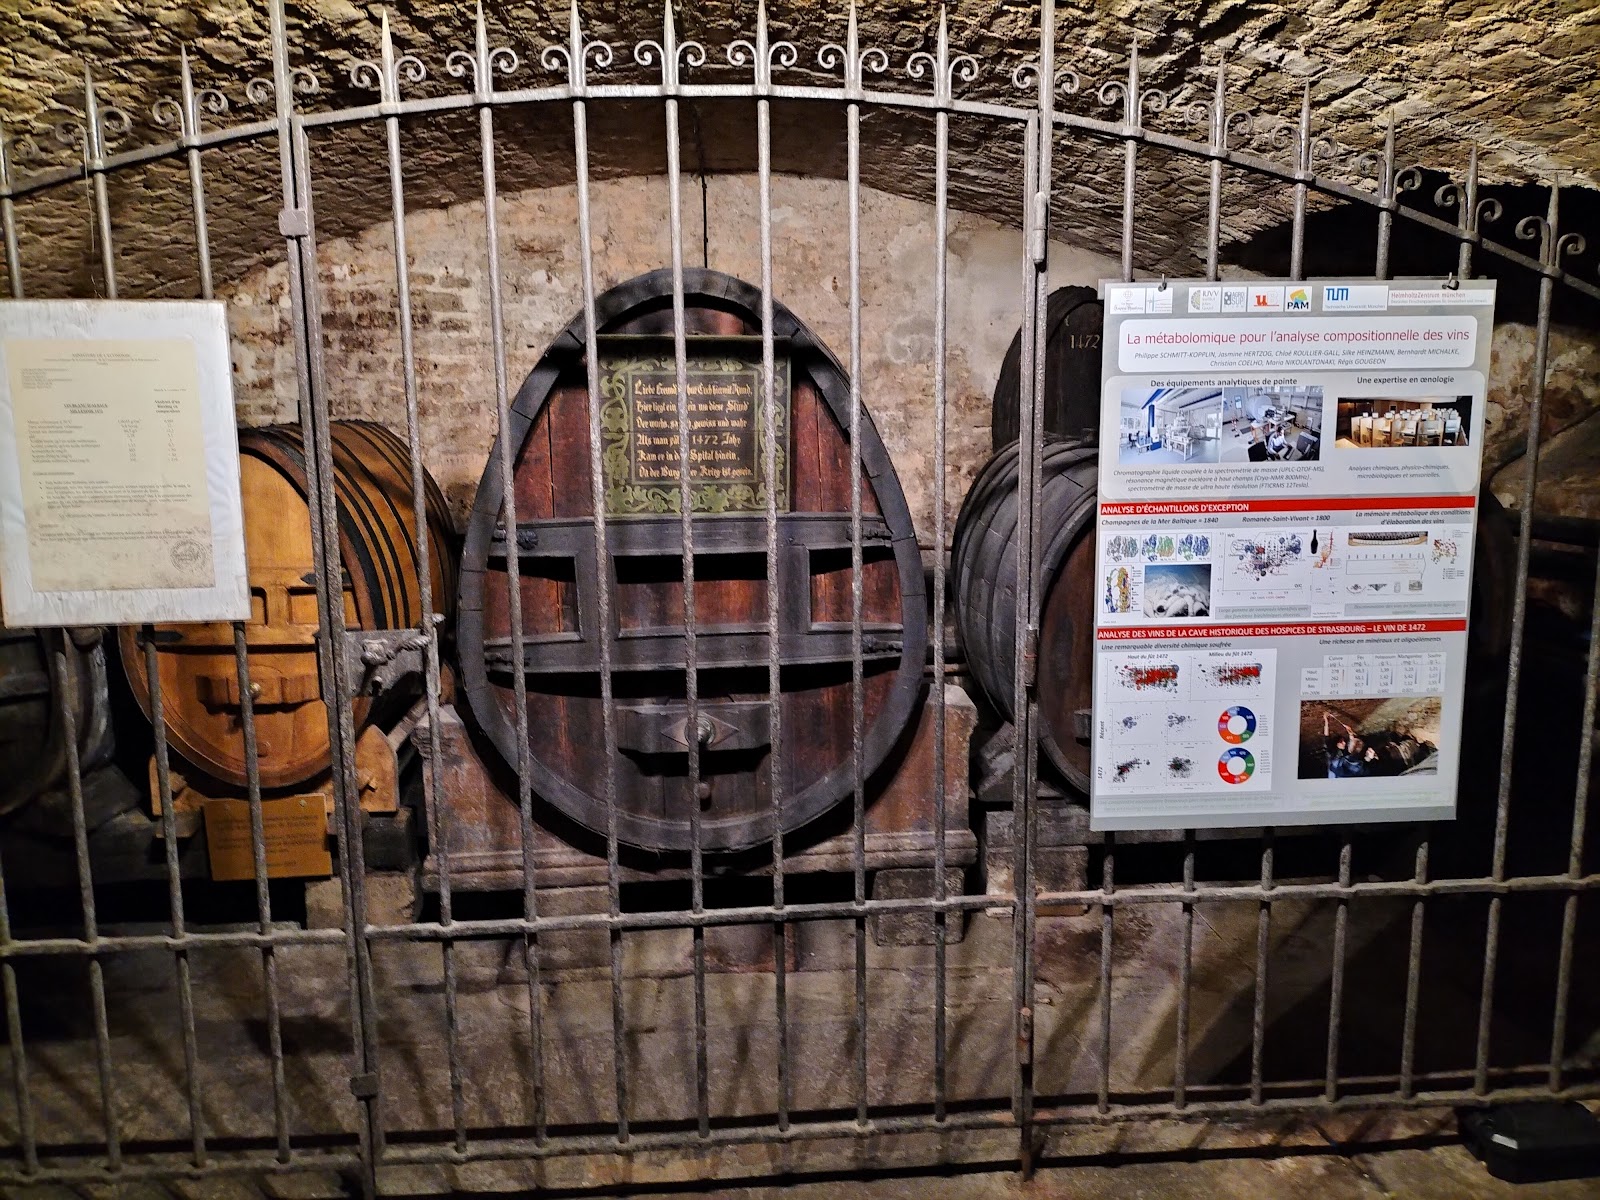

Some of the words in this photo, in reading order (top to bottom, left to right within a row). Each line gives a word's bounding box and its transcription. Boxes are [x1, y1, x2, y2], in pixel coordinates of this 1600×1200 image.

[1287, 301, 1309, 310] PAM
[1070, 334, 1100, 350] 1472
[1127, 333, 1141, 345] La
[1145, 331, 1236, 345] métabolomique
[1240, 332, 1267, 345] pour
[1323, 329, 1420, 344] compositionnelle
[1423, 329, 1443, 341] des
[1447, 329, 1470, 341] vins
[1134, 352, 1159, 360] Philippe
[1159, 351, 1216, 359] SCHMITT-KOPPLIN,
[1243, 350, 1273, 358] HERTZOG,
[1356, 349, 1396, 357] HEINZMANN,
[1427, 348, 1460, 356] MICHALKE,
[1238, 359, 1265, 367] COELHO,
[1285, 358, 1336, 366] NIKOLANTONAKI,
[1338, 358, 1353, 366] Régis
[1166, 379, 1216, 388] équipements
[1217, 379, 1261, 388] analytiques
[1273, 378, 1298, 387] pointe
[1357, 376, 1372, 384] Une
[1373, 376, 1408, 385] expertise
[717, 416, 730, 428] und
[692, 434, 719, 445] 1472
[1113, 469, 1161, 477] Chromatographie
[1181, 468, 1201, 476] couplée
[1215, 467, 1252, 475] spectrométrie
[1154, 477, 1188, 485] magnétique
[1101, 505, 1135, 514] ANALYSE
[1101, 518, 1140, 527] Champagnes
[1242, 514, 1310, 522] Romanée-Saint-Vivant
[1098, 630, 1131, 639] ANALYSE
[1133, 630, 1147, 638] DES
[1148, 629, 1166, 638] VINS
[1167, 629, 1177, 637] DE
[1178, 629, 1187, 637] LA
[1188, 628, 1208, 637] CAVE
[1209, 627, 1254, 637] HISTORIQUE
[1255, 627, 1269, 635] DES
[1270, 626, 1306, 635] HOSPICES
[1307, 625, 1317, 634] DE
[1318, 625, 1366, 633] STRASBOURG
[1373, 624, 1381, 632] LE
[1382, 624, 1396, 632] VIN
[1408, 623, 1426, 631] 1472
[1114, 643, 1153, 651] remarquable
[1181, 641, 1208, 649] chimique
[1209, 641, 1232, 649] soufrée
